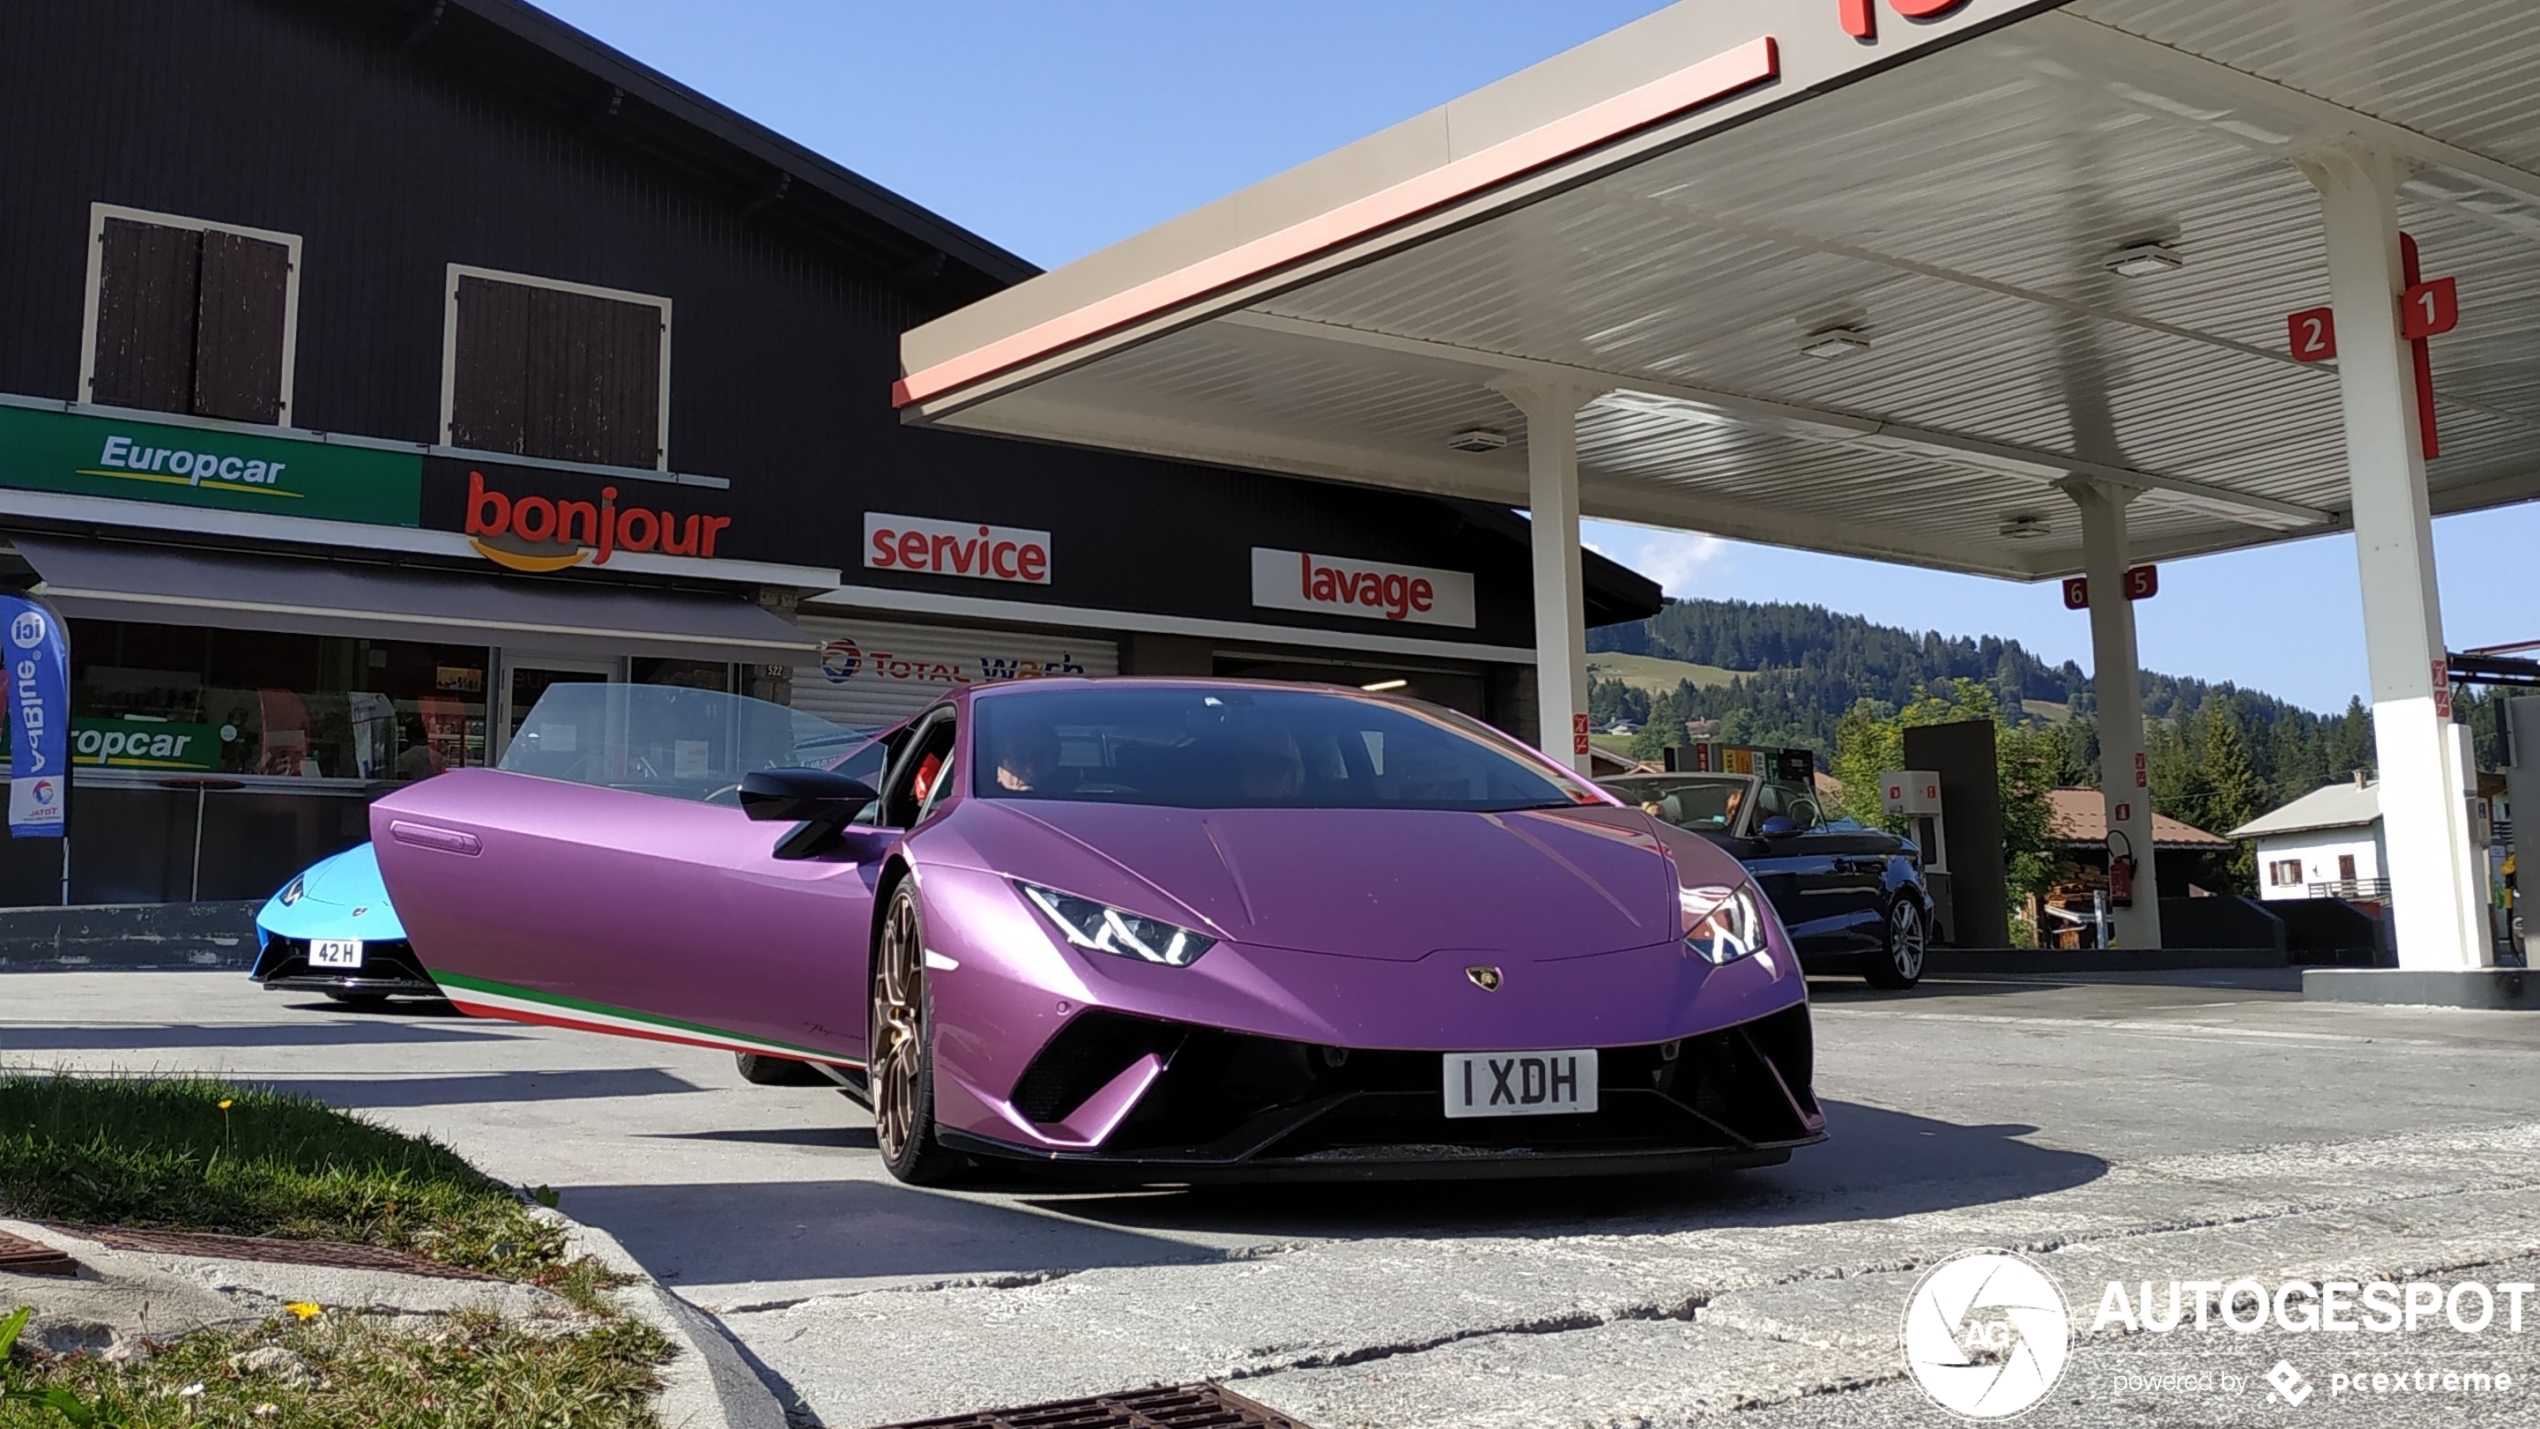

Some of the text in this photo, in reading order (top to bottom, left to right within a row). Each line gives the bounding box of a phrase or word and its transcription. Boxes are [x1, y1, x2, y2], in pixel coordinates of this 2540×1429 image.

[2415, 290, 2436, 326] 1
[2301, 317, 2327, 354] 2
[101, 435, 286, 486] Europcar
[465, 470, 732, 565] bonjour
[871, 526, 1047, 580] service
[1302, 552, 1434, 621] lavage
[2070, 582, 2084, 604] 6
[2133, 571, 2149, 595] 5
[869, 652, 971, 683] TOTAL
[318, 942, 354, 963] 42 H
[1488, 1056, 1578, 1106] XDH
